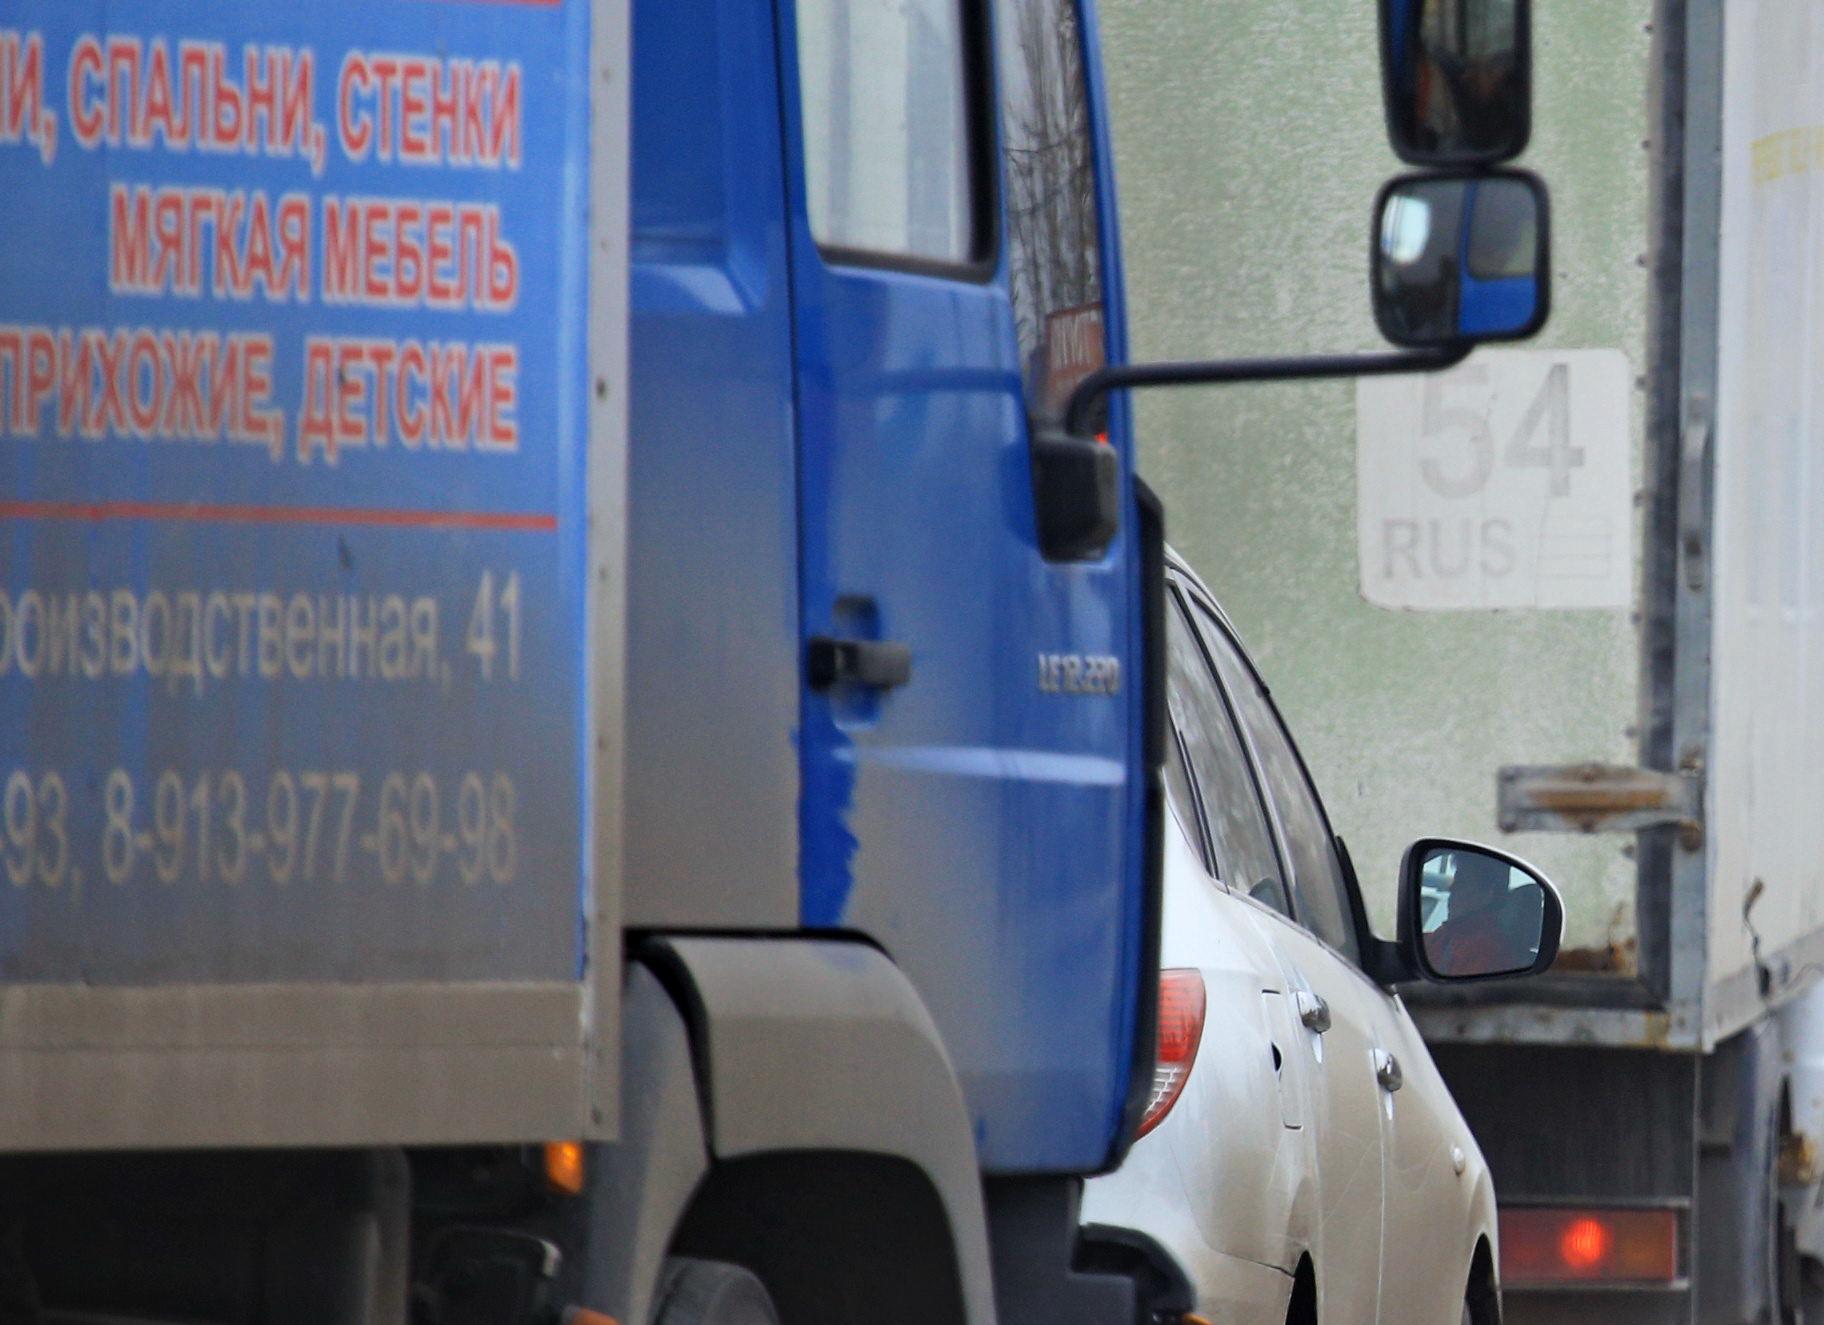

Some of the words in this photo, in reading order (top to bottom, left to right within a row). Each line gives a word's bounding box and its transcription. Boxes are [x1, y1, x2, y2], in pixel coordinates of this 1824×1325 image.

[0, 31, 56, 166] И,
[68, 35, 326, 178] СПАЛЬНИ,
[336, 49, 523, 170] СТЕНКИ
[108, 182, 312, 298] МЯГКАЯ
[321, 196, 520, 311] МЕБЕЛЬ
[297, 334, 520, 464] ДЕТСКИЕ
[1417, 362, 1588, 500] 54
[1380, 518, 1518, 579] RUS
[465, 569, 523, 682] 41
[102, 768, 520, 885] 8-913-977-69-98
